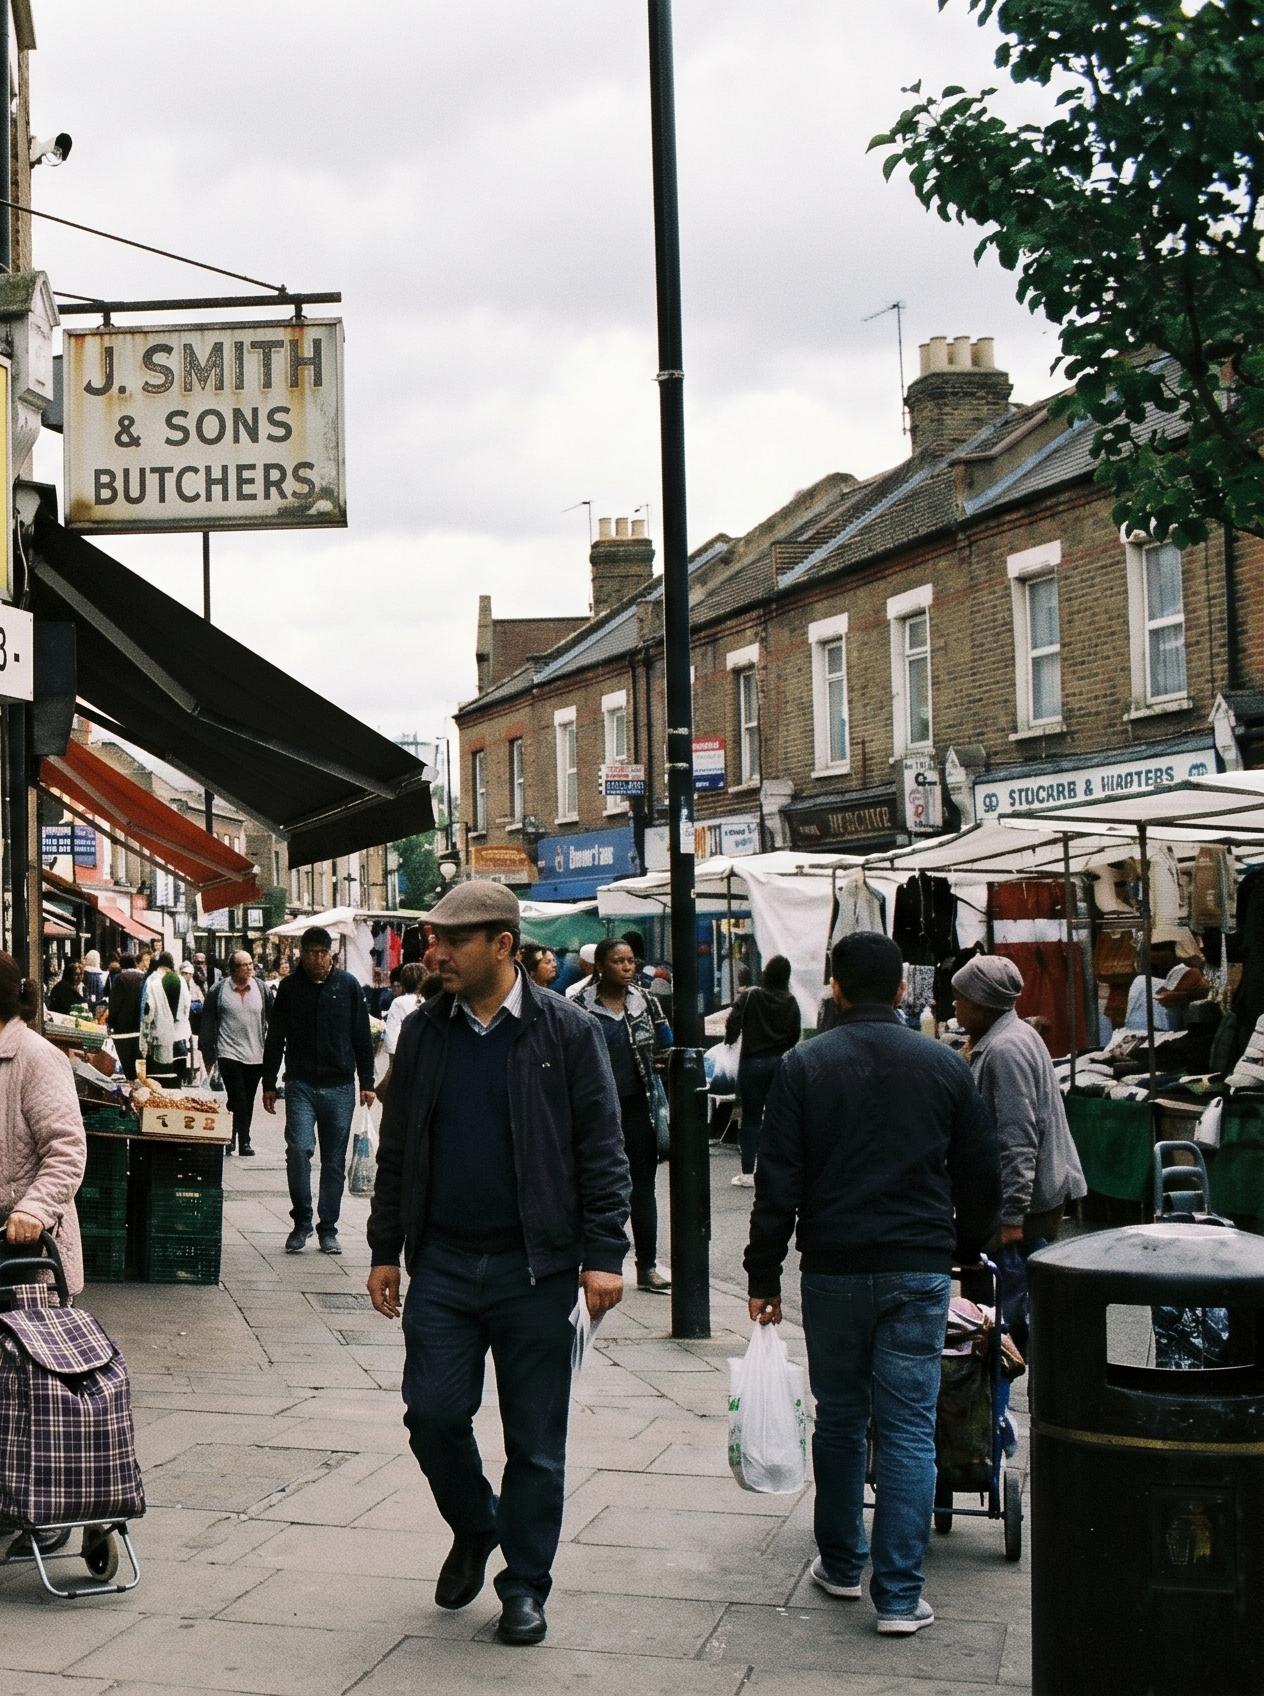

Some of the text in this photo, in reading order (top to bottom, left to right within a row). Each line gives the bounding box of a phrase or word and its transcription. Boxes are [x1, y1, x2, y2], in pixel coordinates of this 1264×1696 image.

[83, 338, 323, 397] J. SMITH
[114, 405, 293, 448] & SONS
[93, 461, 316, 506] BUTCHERS
[1083, 778, 1094, 797] &
